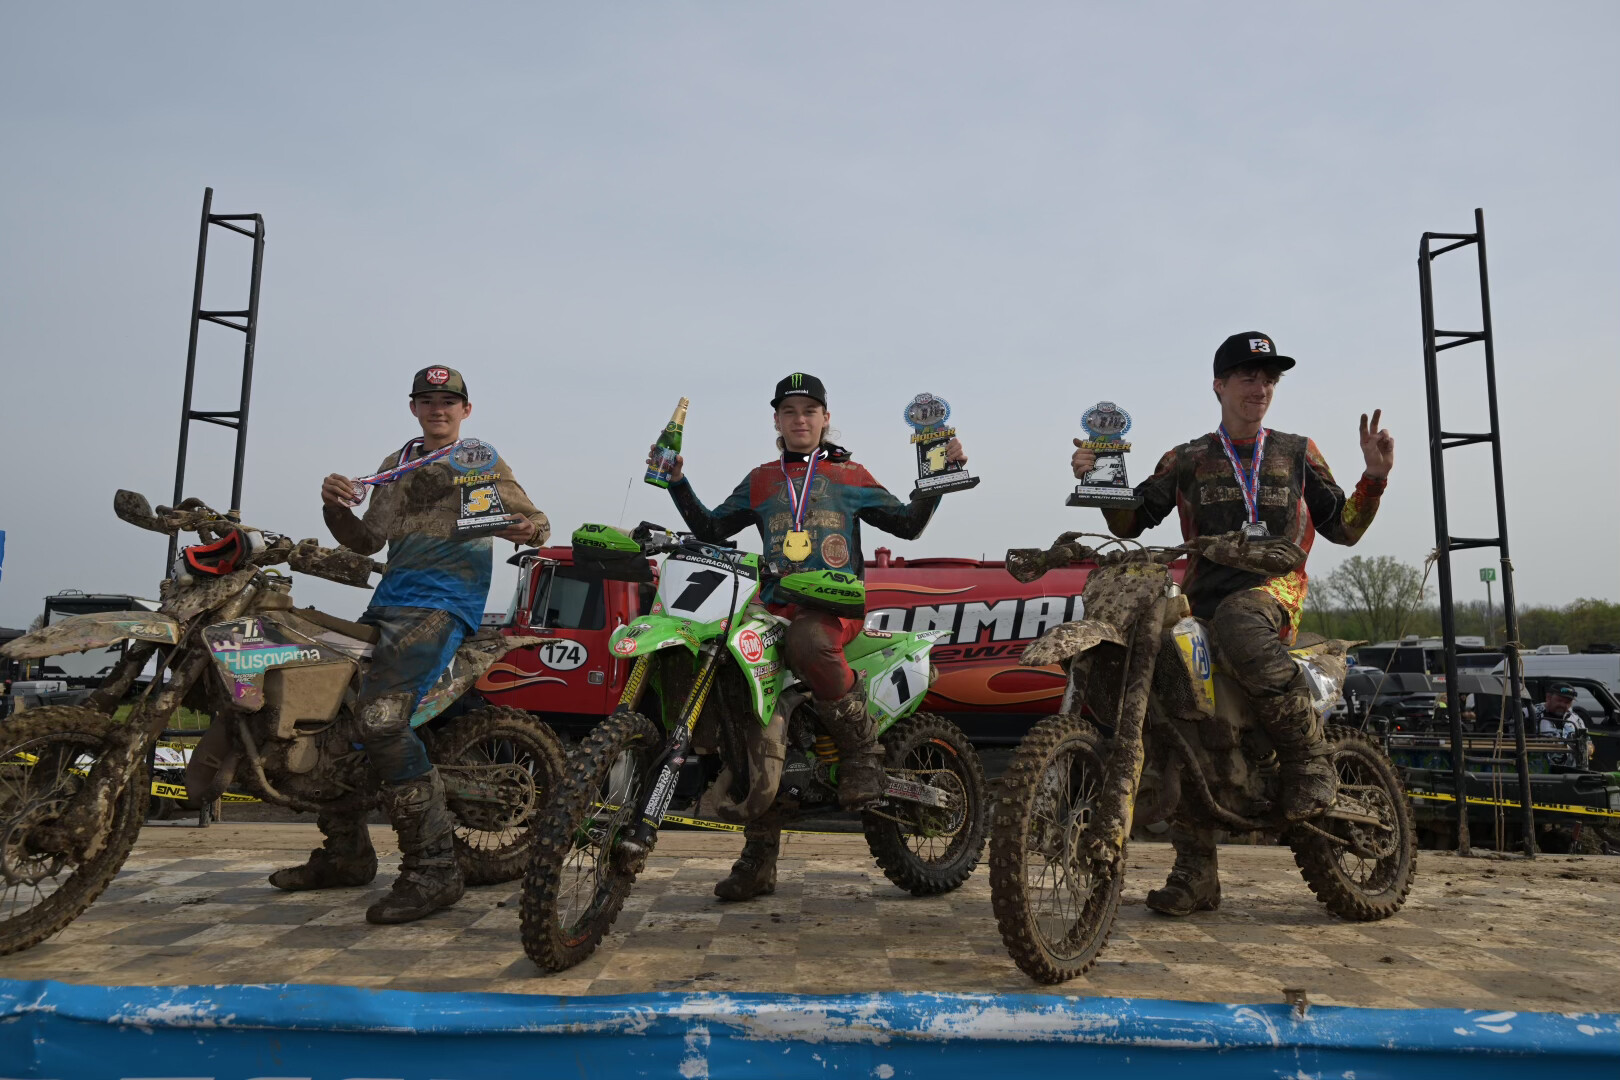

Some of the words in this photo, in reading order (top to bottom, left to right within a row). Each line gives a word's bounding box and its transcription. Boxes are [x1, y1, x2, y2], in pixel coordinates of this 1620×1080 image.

[1249, 339, 1271, 353] F3
[426, 371, 448, 381] XC
[910, 429, 956, 444] HOOSIER
[1082, 440, 1132, 450] HOOSIER
[453, 473, 501, 486] HOOSIER
[580, 524, 608, 533] ASV
[573, 537, 607, 548] ACERBIS
[822, 571, 856, 585] ASV
[670, 569, 728, 613] 1
[814, 586, 862, 598] ACERBIS
[225, 648, 320, 670] Husqvarna
[545, 645, 580, 664] 174
[890, 666, 910, 705] 1
